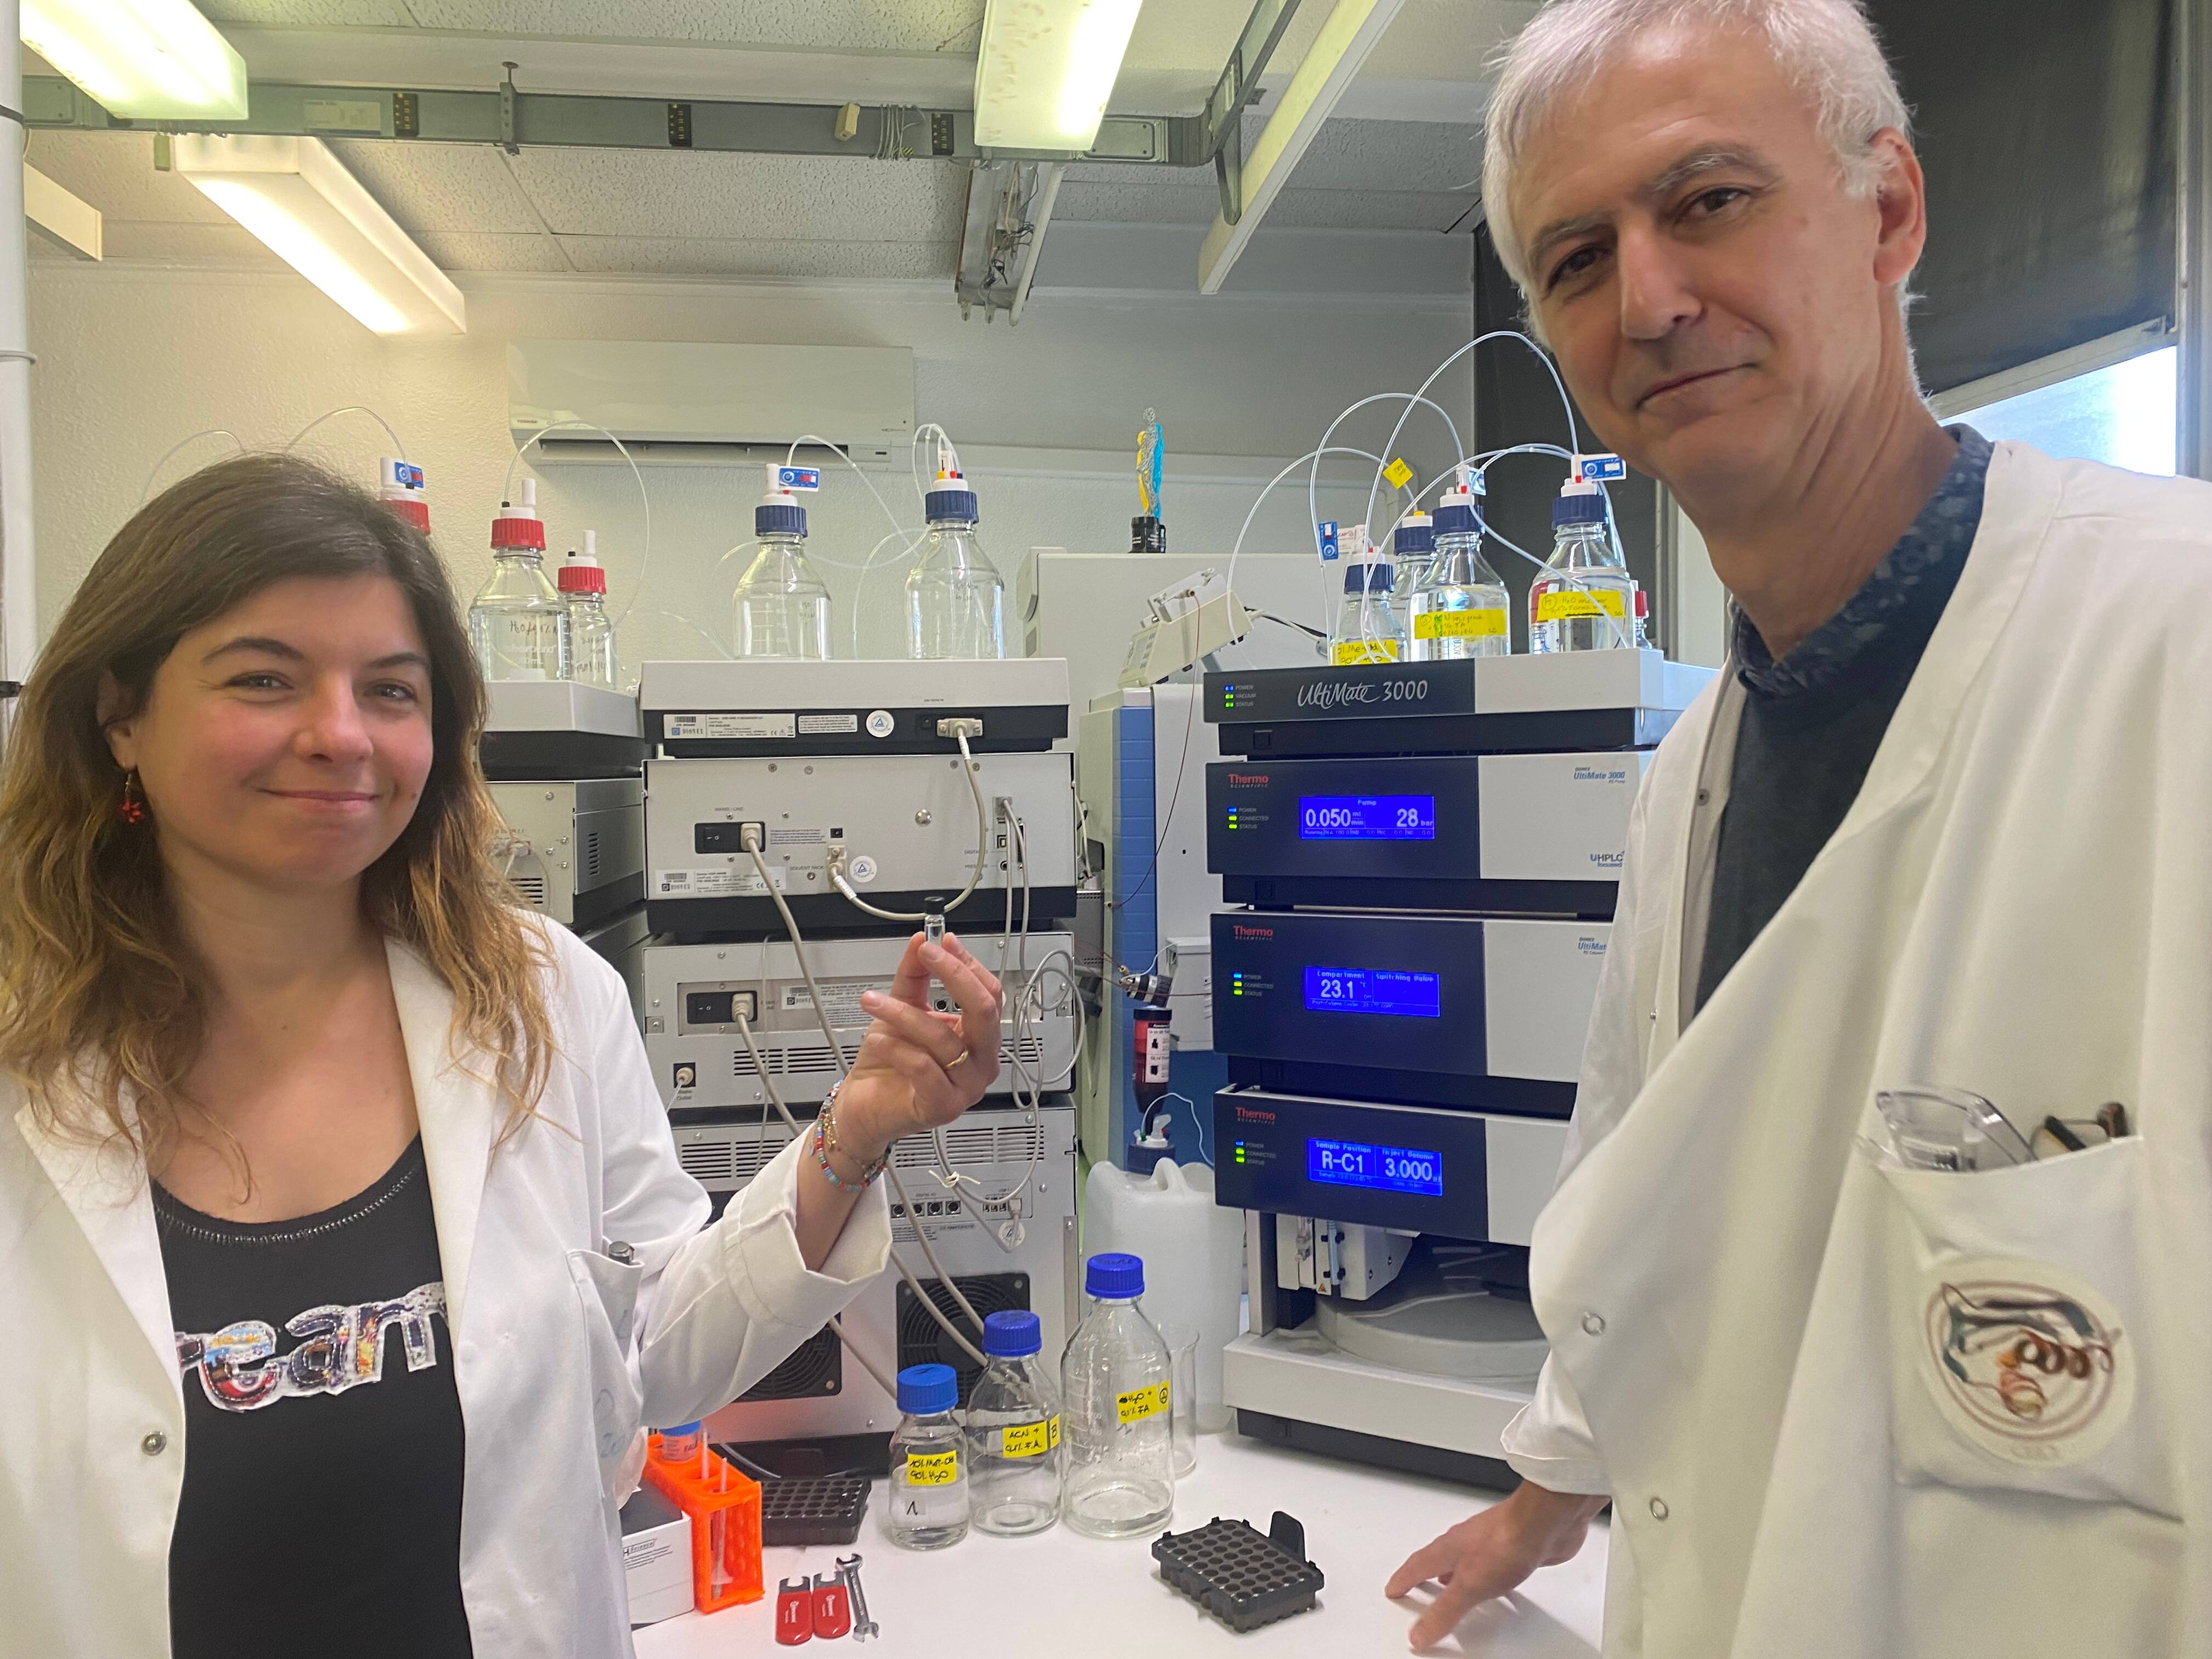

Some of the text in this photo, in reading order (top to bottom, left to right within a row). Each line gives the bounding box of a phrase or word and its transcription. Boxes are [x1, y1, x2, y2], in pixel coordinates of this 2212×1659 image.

[1297, 680, 1427, 709] UltiMate 3000
[1228, 773, 1269, 783] Thermo
[1574, 771, 1606, 780] UltiMate
[1305, 808, 1351, 827] 0.050
[1396, 808, 1419, 827] 28
[1590, 853, 1623, 862] UHPLC
[1233, 925, 1273, 937] Thermo
[1578, 942, 1606, 951] UltiMat
[1317, 970, 1365, 979] Compartment
[1375, 973, 1410, 982] Switching
[1321, 979, 1354, 999] 23.1
[1235, 1107, 1276, 1120] Thermo
[1316, 1141, 1371, 1153] Sample Position
[1322, 1150, 1363, 1173] R-C1
[1385, 1158, 1432, 1181] 3.000
